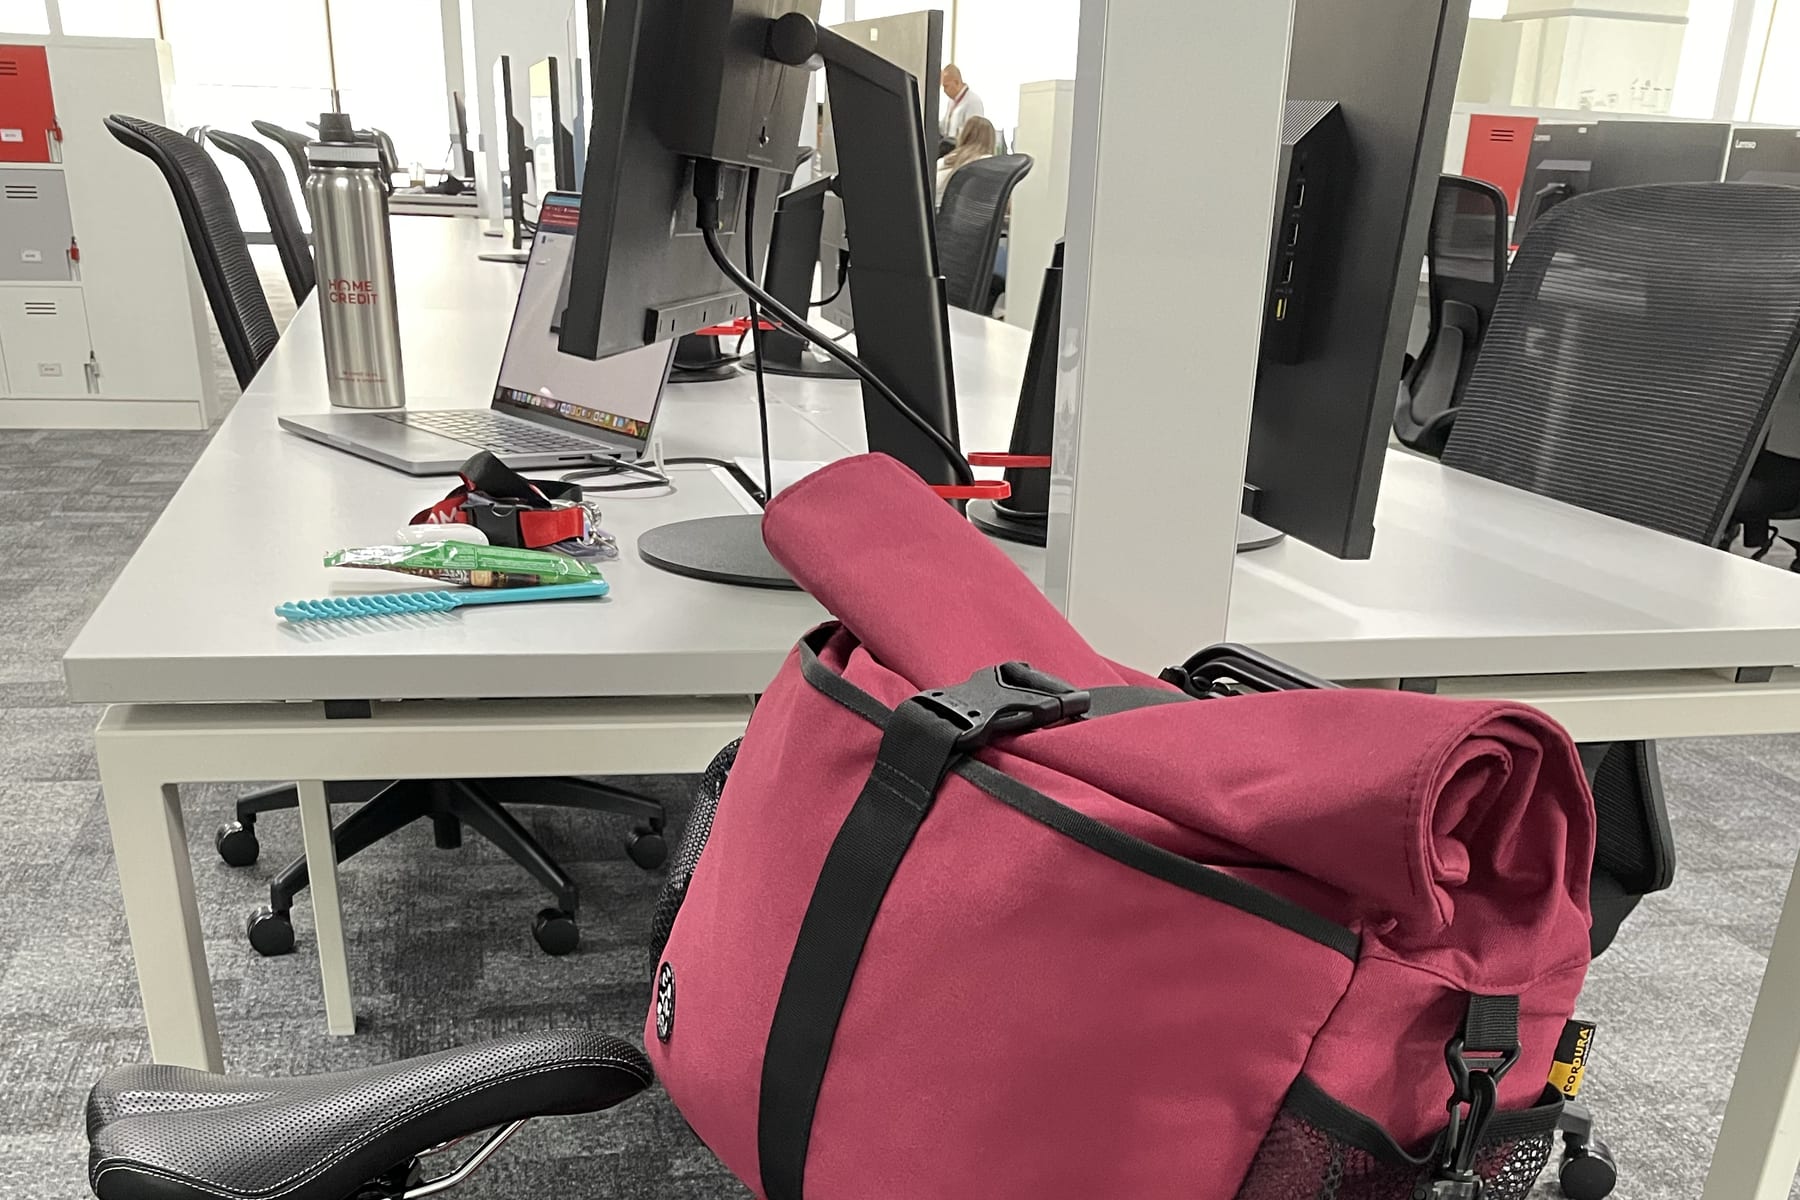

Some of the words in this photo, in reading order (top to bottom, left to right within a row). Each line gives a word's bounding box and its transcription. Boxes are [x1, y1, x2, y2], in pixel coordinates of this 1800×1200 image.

[328, 279, 373, 291] HOME
[329, 292, 378, 305] CREDIT
[1563, 1027, 1590, 1093] CORDURA
